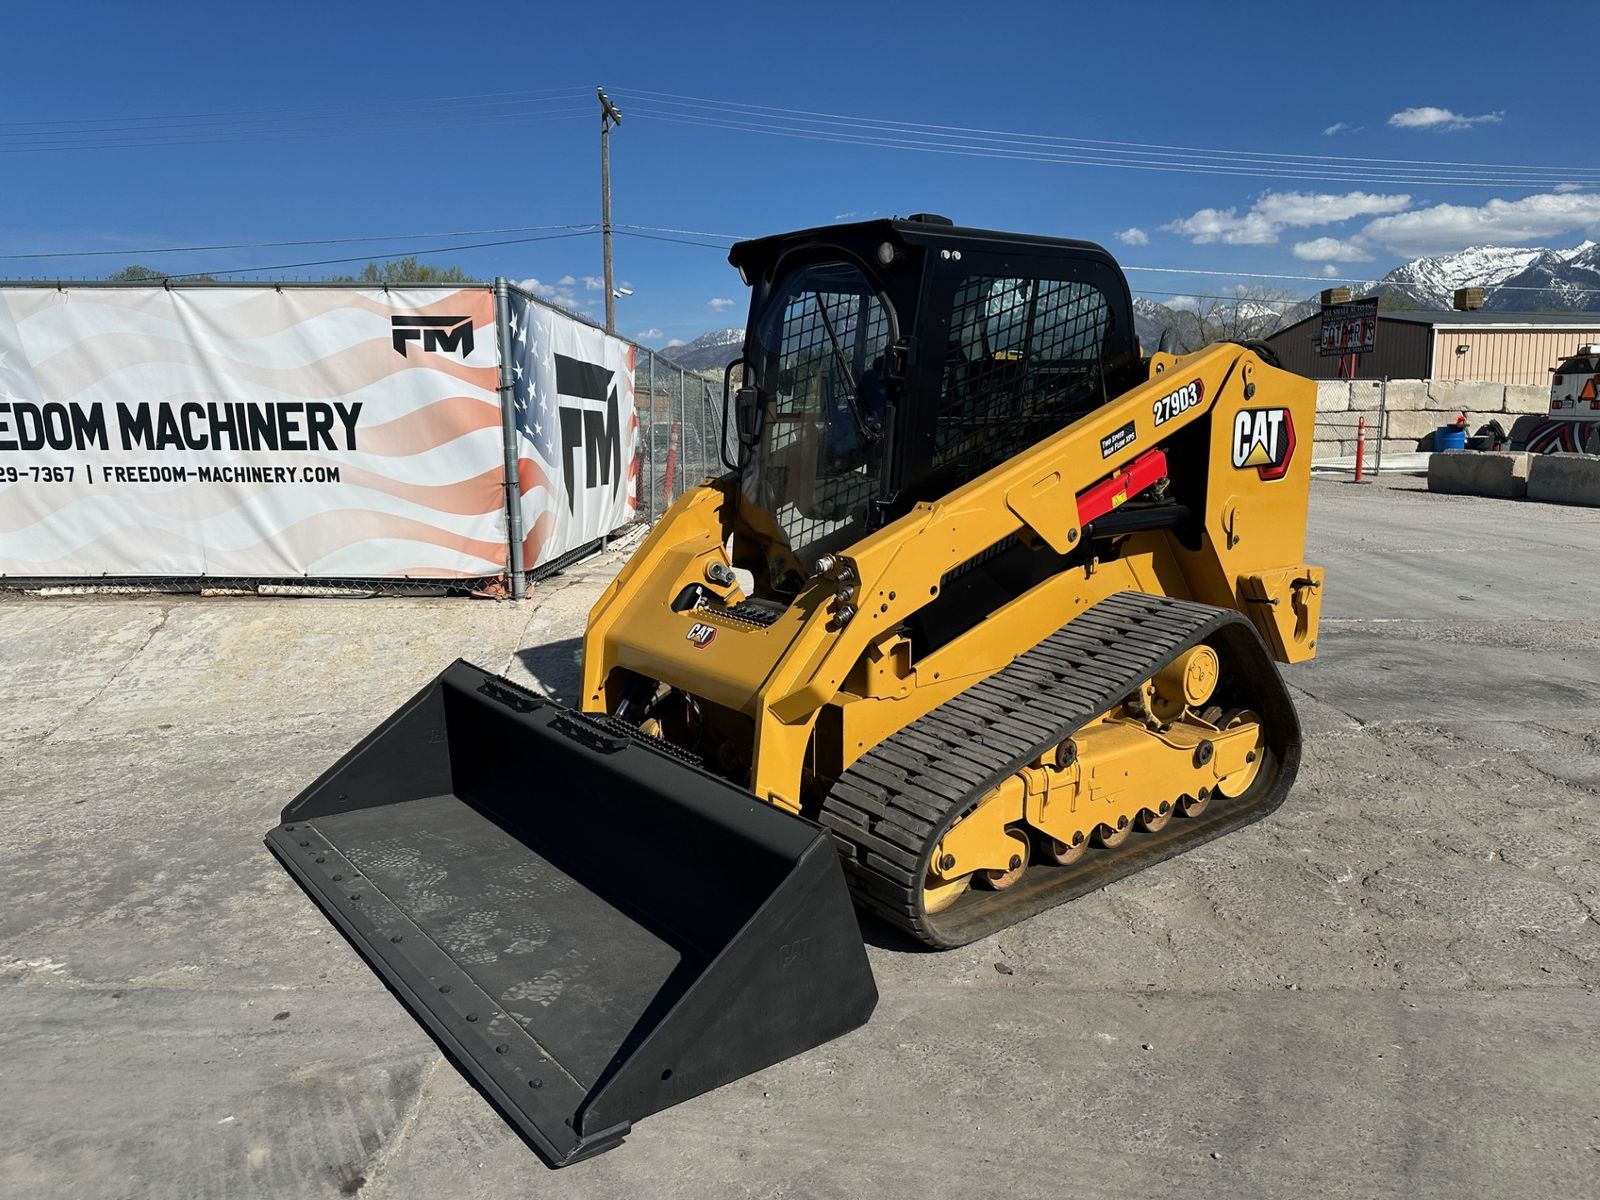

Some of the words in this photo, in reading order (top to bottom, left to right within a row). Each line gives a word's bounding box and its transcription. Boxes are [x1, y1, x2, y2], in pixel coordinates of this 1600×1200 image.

[391, 316, 475, 359] FM
[1154, 382, 1198, 426] 279D3
[116, 402, 363, 451] MACHINERY
[554, 352, 621, 517] FM
[1233, 410, 1284, 468] CAT
[0, 466, 75, 482] 29-7367
[103, 466, 341, 483] FREEDOM-MACHINERY.COM
[686, 623, 714, 642] CAT
